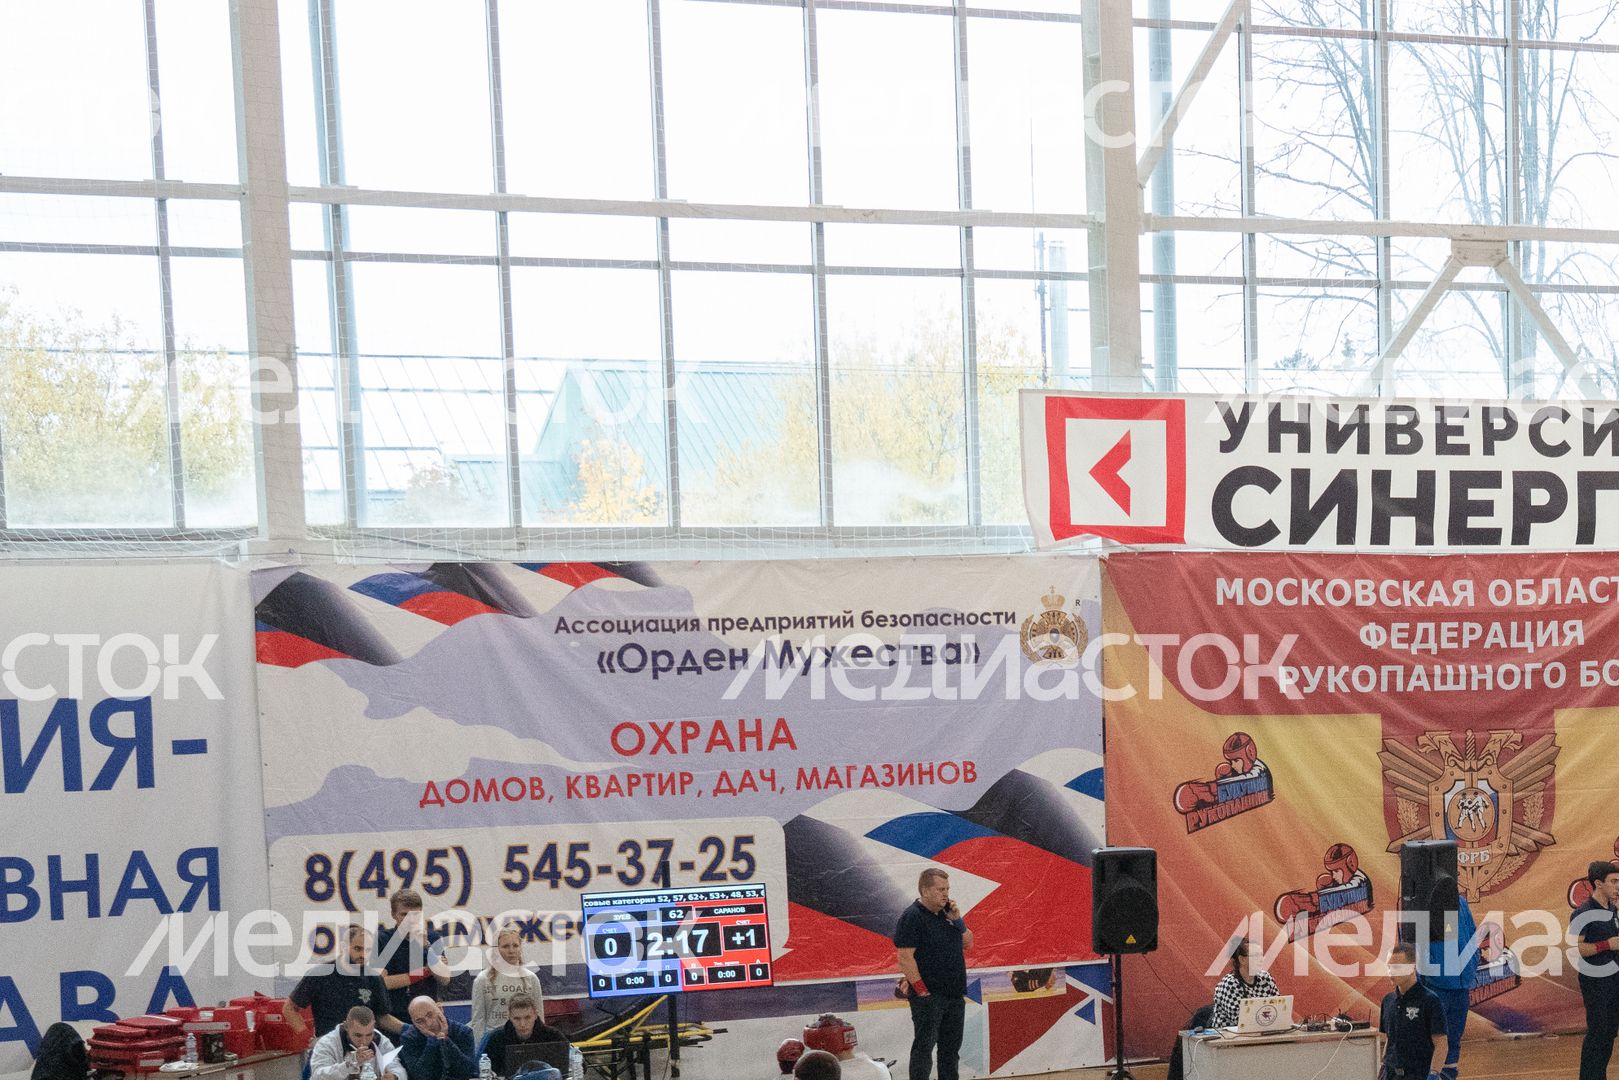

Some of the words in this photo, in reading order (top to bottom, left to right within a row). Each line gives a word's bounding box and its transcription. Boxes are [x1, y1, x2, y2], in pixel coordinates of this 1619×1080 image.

[1215, 577, 1475, 607] МОСКОВСКАЯ
[554, 616, 701, 637] Ассоциация
[708, 609, 856, 636] предприятий
[860, 608, 1017, 630] безопасности
[1359, 620, 1585, 655] ФЕДЕРАЦИЯ
[598, 642, 749, 680] «Орден
[763, 637, 981, 675] Мужества»
[1278, 662, 1569, 694] РУКОПАШНОГО
[610, 717, 798, 757] ОХРАНА
[419, 776, 555, 809] ДОМОВ,
[565, 770, 703, 801] КВАРТИР,
[713, 767, 786, 798] ДАЧ,
[797, 760, 979, 792] МАГАЗИНОВ
[304, 846, 471, 911] 8(495)
[502, 835, 756, 893] 545-37-25
[611, 897, 655, 905] категории
[673, 894, 686, 902] 57,
[688, 893, 707, 901] 62+,
[710, 892, 728, 900] 53+,
[746, 890, 759, 898] 53,
[669, 910, 684, 918] 62
[647, 929, 709, 956] 2:17
[732, 929, 756, 946] +1
[605, 938, 617, 955] 0
[626, 976, 644, 985] 0:00
[665, 974, 671, 982] 0
[691, 972, 697, 980] 0
[718, 970, 735, 978] 0:00
[756, 968, 762, 976] 0
[598, 979, 606, 987] 0
